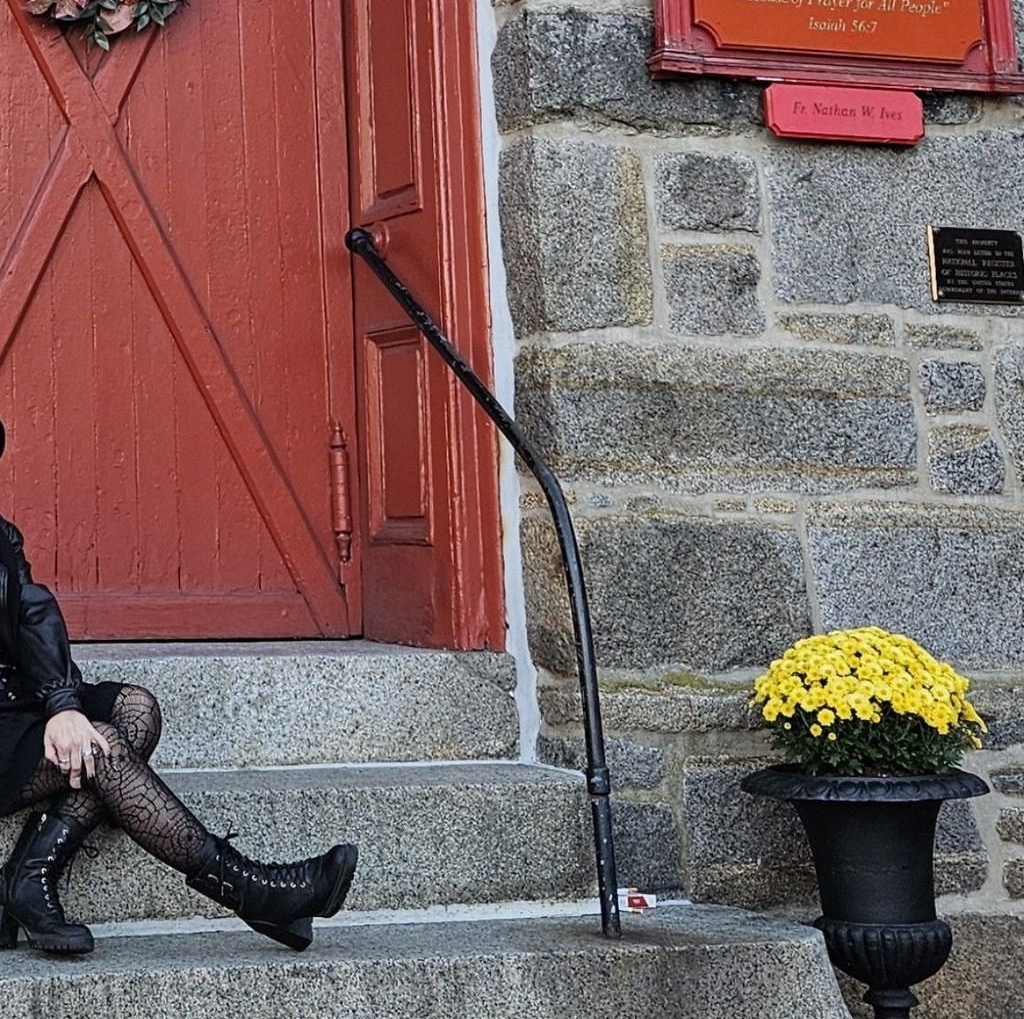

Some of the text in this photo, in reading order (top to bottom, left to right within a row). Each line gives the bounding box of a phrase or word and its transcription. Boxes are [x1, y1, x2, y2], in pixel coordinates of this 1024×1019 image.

[808, 17, 878, 33] Isaiah 56:7
[793, 102, 902, 120] Fr. Nathan W. Ives
